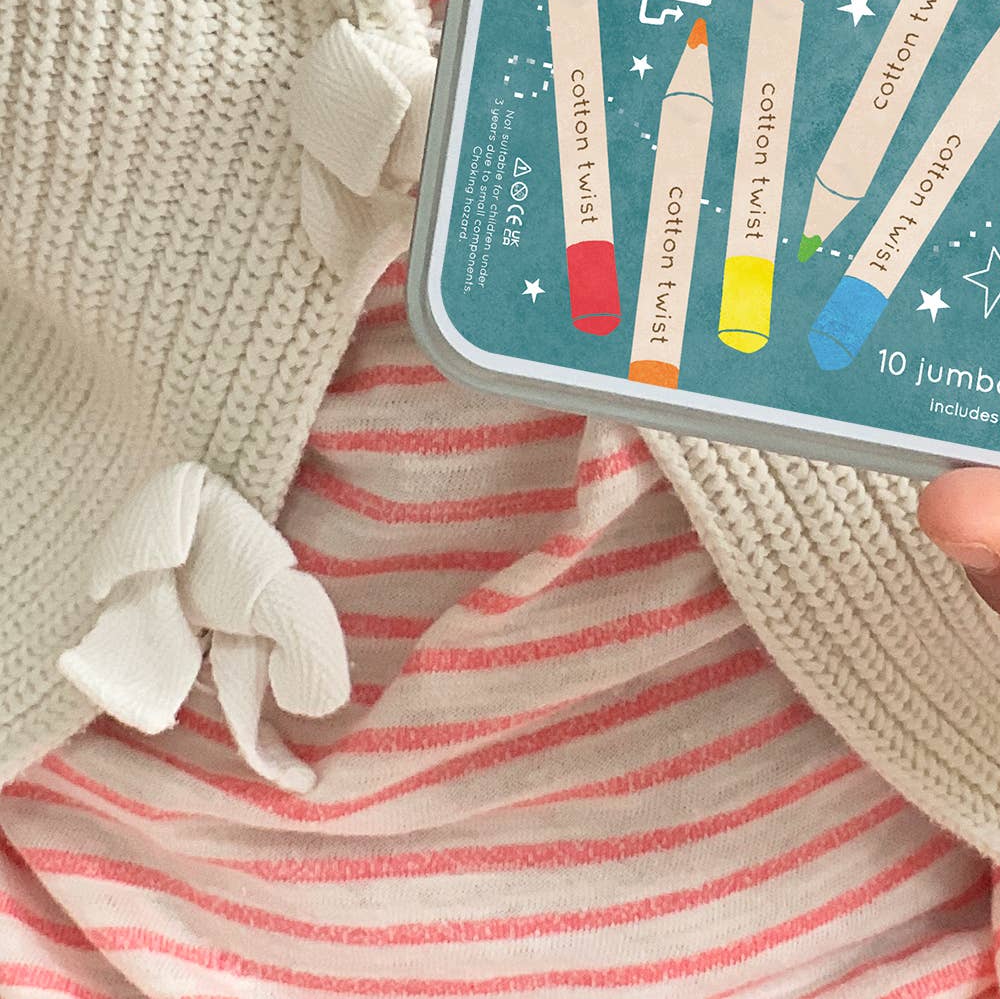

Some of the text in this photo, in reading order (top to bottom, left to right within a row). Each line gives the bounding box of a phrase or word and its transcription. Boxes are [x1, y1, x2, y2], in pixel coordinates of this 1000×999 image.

[873, 32, 920, 110] cotton
[458, 145, 483, 242] Choking hazard.
[463, 97, 505, 294] 3 years due to small components.
[478, 109, 515, 288] Not suitable for children under
[570, 69, 599, 225] cotton twist
[744, 82, 777, 239] cotton twist
[869, 134, 962, 272] cotton twist
[649, 186, 684, 344] cotton twist
[878, 348, 907, 376] 10
[929, 398, 999, 424] includes
